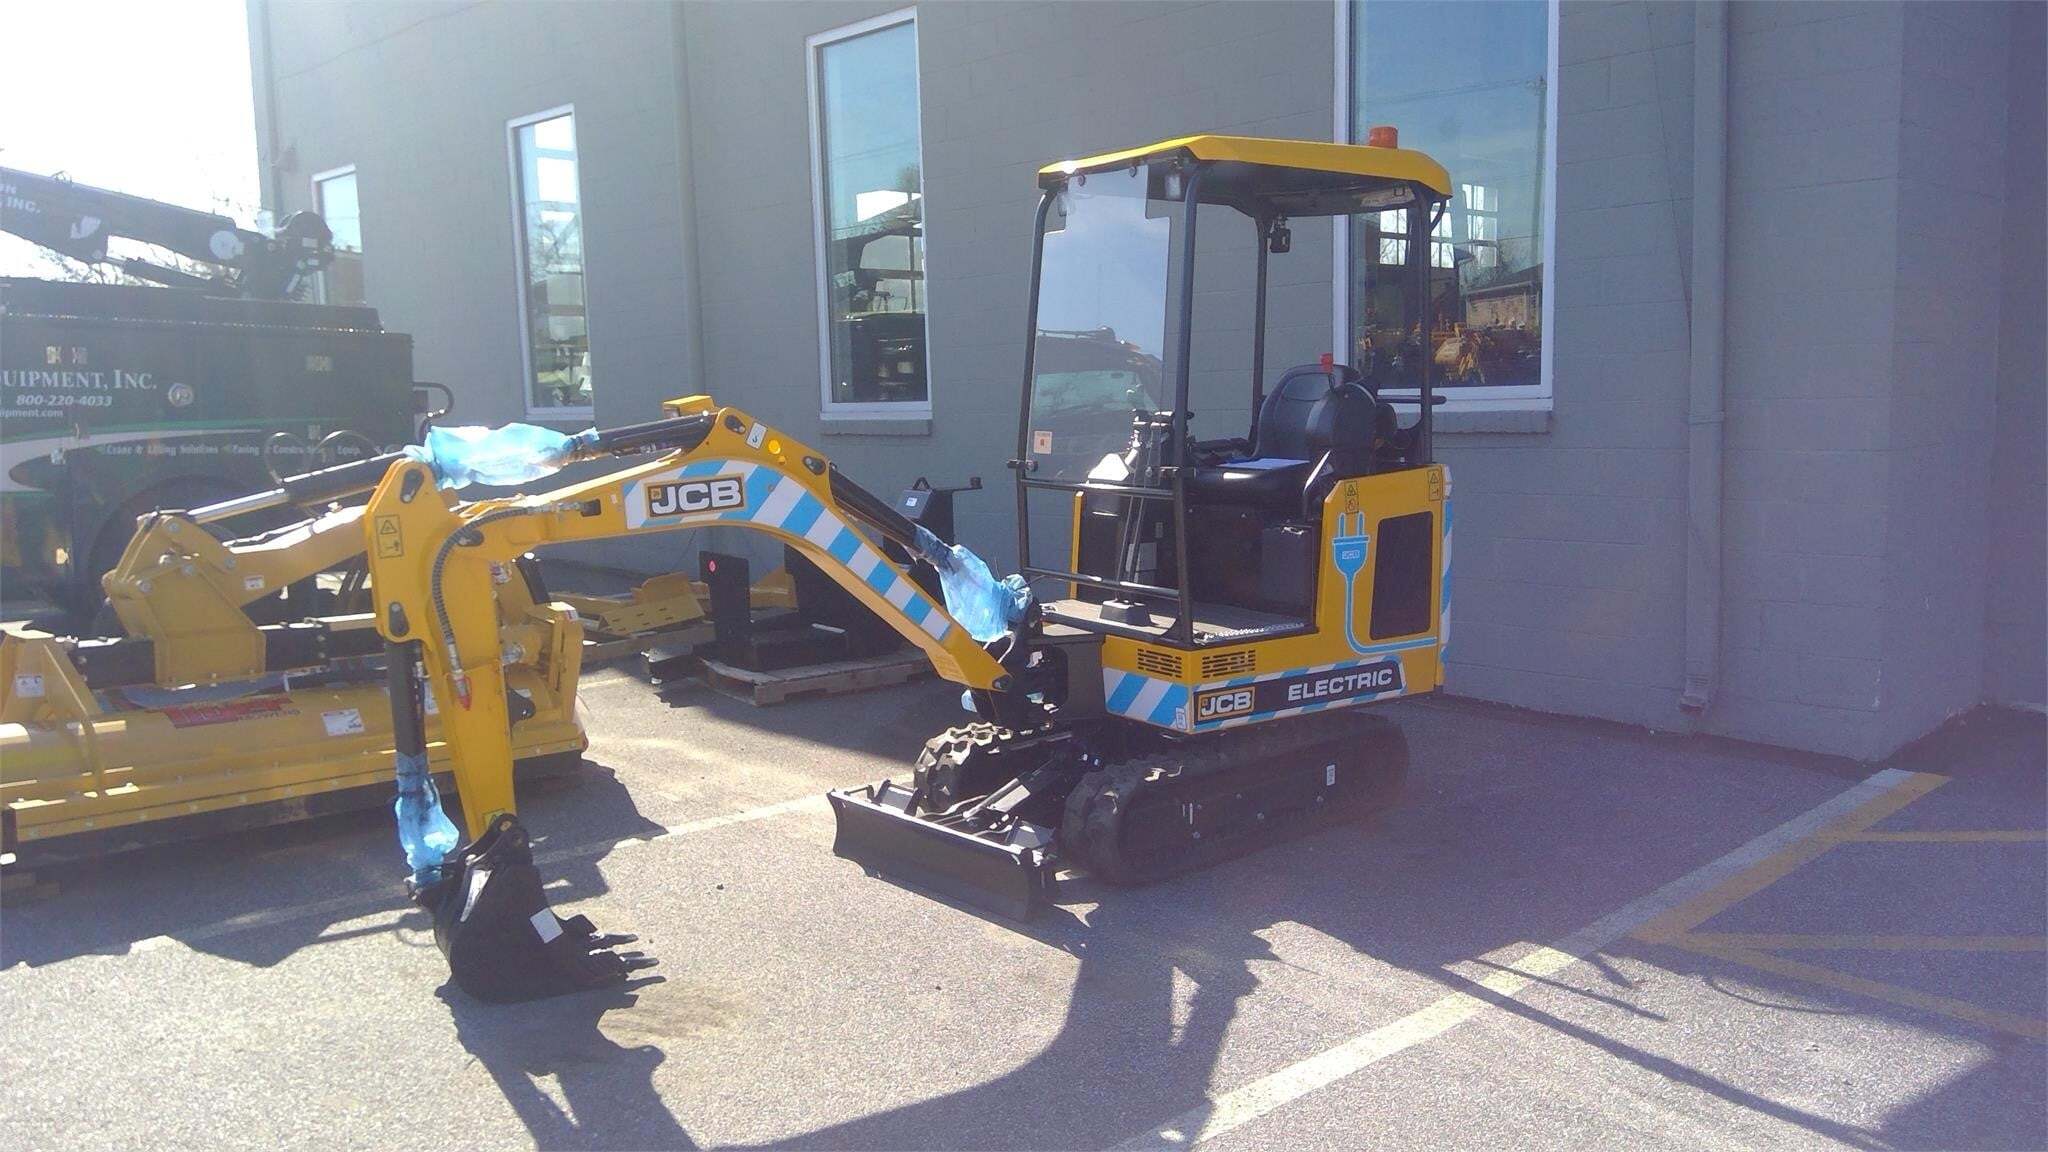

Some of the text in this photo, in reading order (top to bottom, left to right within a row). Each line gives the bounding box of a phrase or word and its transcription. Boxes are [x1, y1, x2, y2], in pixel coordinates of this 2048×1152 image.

[7, 196, 40, 213] INC.
[0, 369, 109, 391] UIPMENT,
[16, 395, 113, 407] 800-220-4033
[652, 480, 741, 515] JCB
[1201, 668, 1393, 716] JCB ELECTRIC
